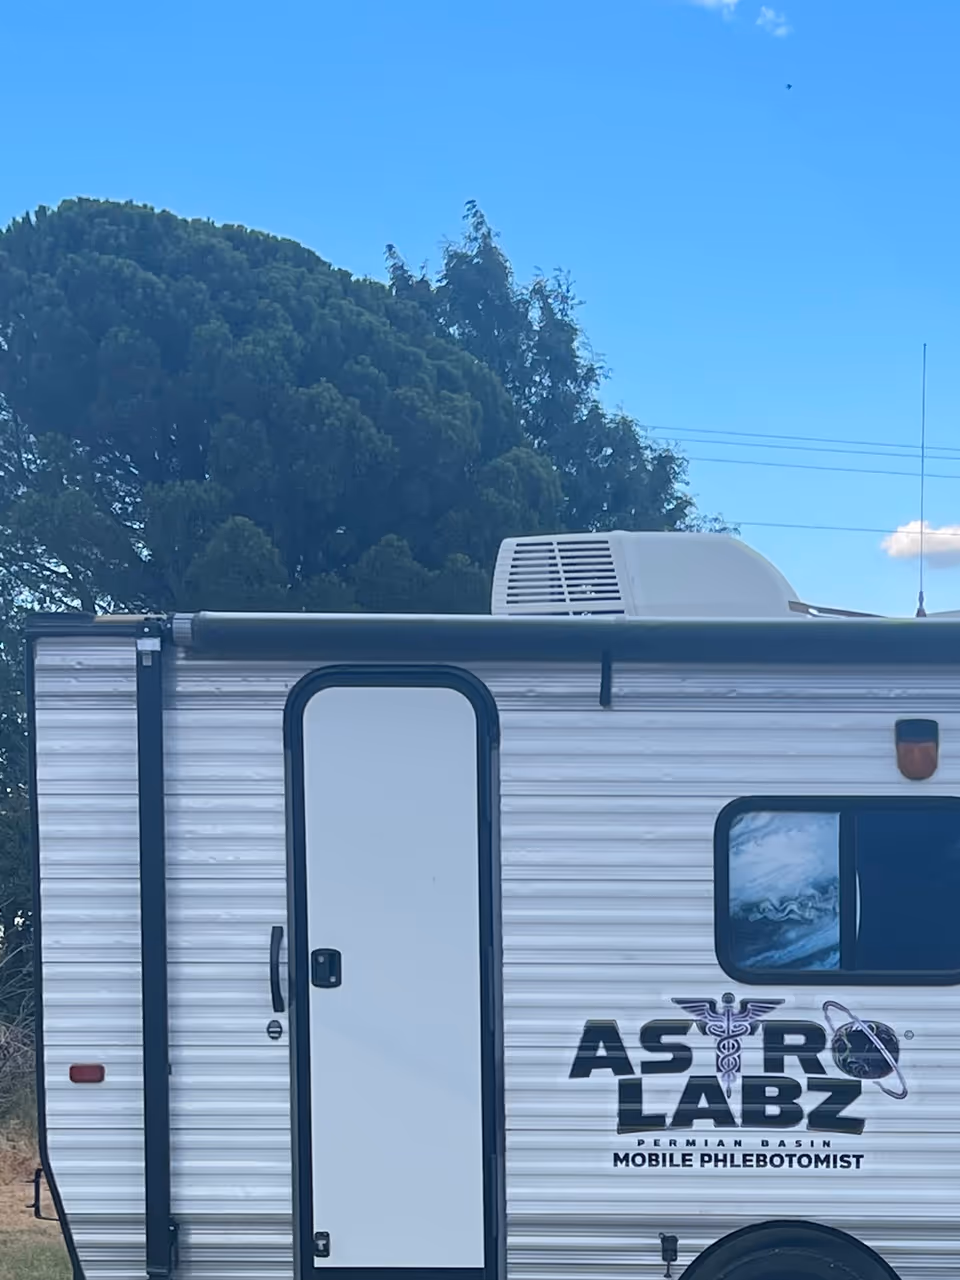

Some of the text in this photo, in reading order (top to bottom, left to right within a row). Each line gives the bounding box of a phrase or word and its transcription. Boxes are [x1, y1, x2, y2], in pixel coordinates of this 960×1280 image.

[568, 1017, 904, 1080] ASTRO
[616, 1075, 866, 1135] LABZ
[613, 1152, 865, 1169] MOBILE PHLEBOTOMIST
[637, 1138, 831, 1149] PERMIAN BASIN
